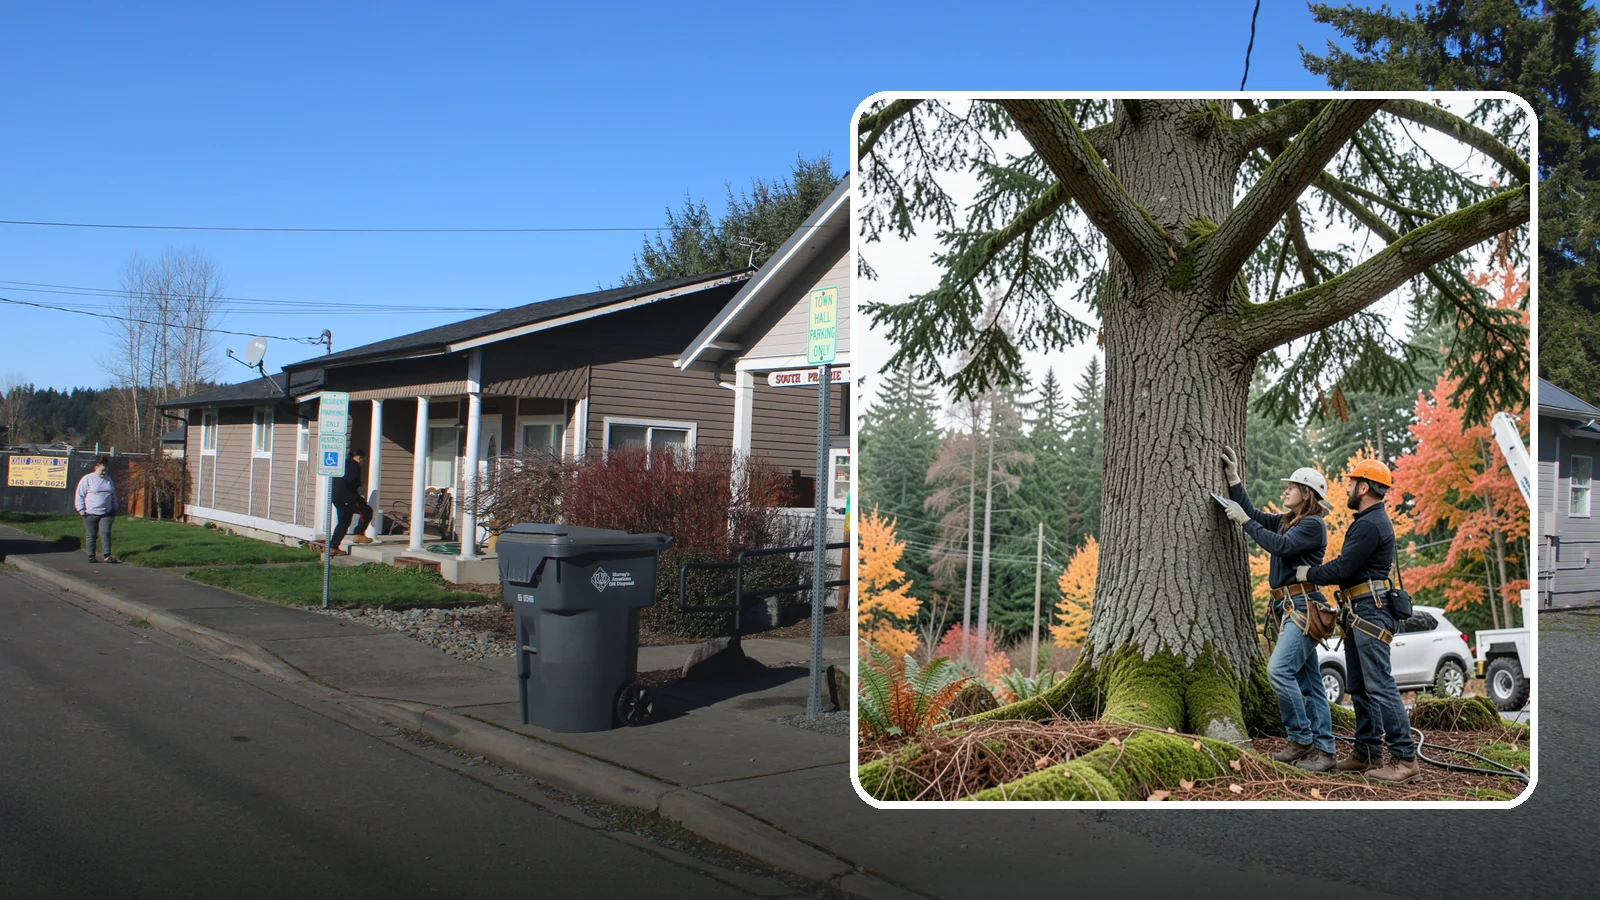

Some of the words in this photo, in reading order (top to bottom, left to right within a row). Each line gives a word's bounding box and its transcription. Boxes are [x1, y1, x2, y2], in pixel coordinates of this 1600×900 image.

[815, 294, 833, 308] TOWN
[814, 311, 831, 325] HALL
[810, 326, 836, 341] PARKING
[813, 343, 831, 358] ONLY
[775, 373, 801, 384] SOUTH
[322, 409, 345, 417] PARKING
[325, 420, 340, 428] ONLY
